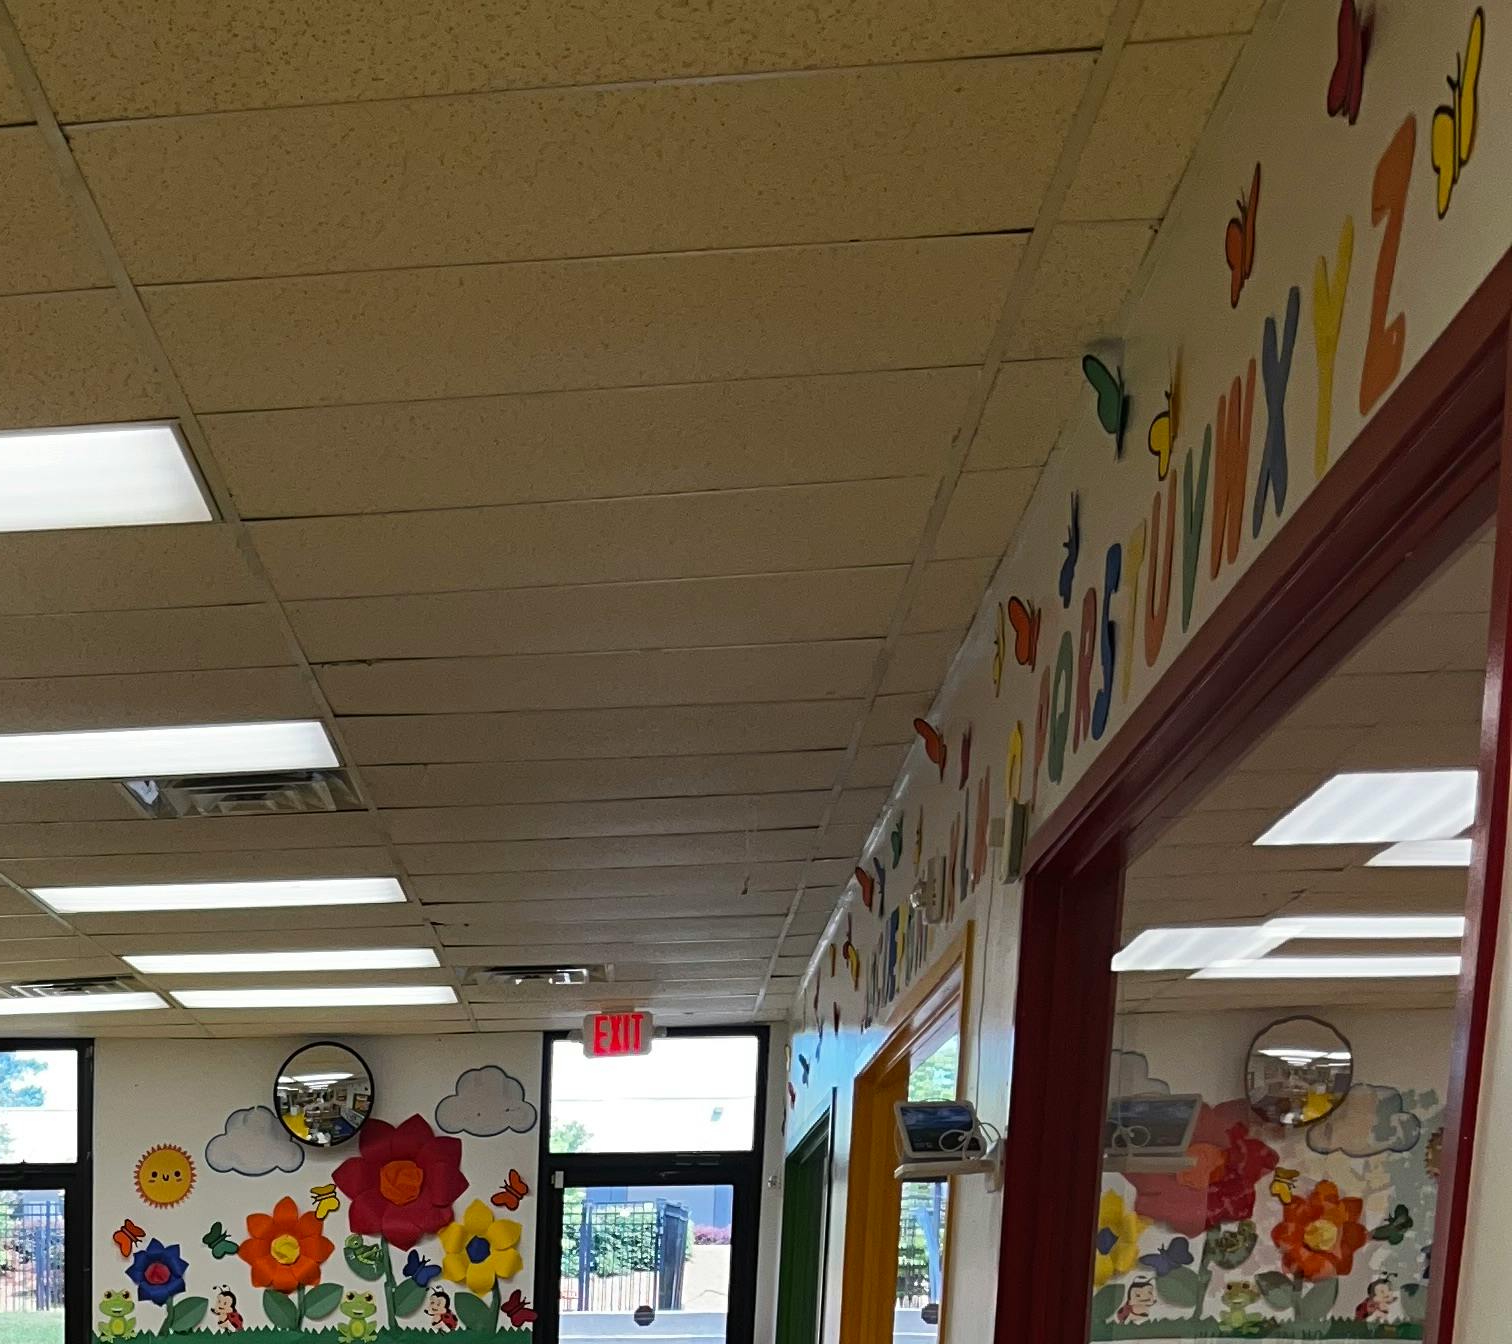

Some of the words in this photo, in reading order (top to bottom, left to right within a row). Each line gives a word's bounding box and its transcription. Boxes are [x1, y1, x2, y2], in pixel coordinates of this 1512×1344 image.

[1073, 587, 1097, 754] R
[1091, 543, 1122, 741] S
[1122, 518, 1147, 704] T
[1144, 468, 1178, 668] U
[1182, 423, 1212, 634] V
[1211, 358, 1256, 581] W
[1252, 286, 1300, 540] X
[1313, 214, 1355, 480] Y
[1359, 113, 1417, 417] Z
[593, 1013, 644, 1056] EXIT
